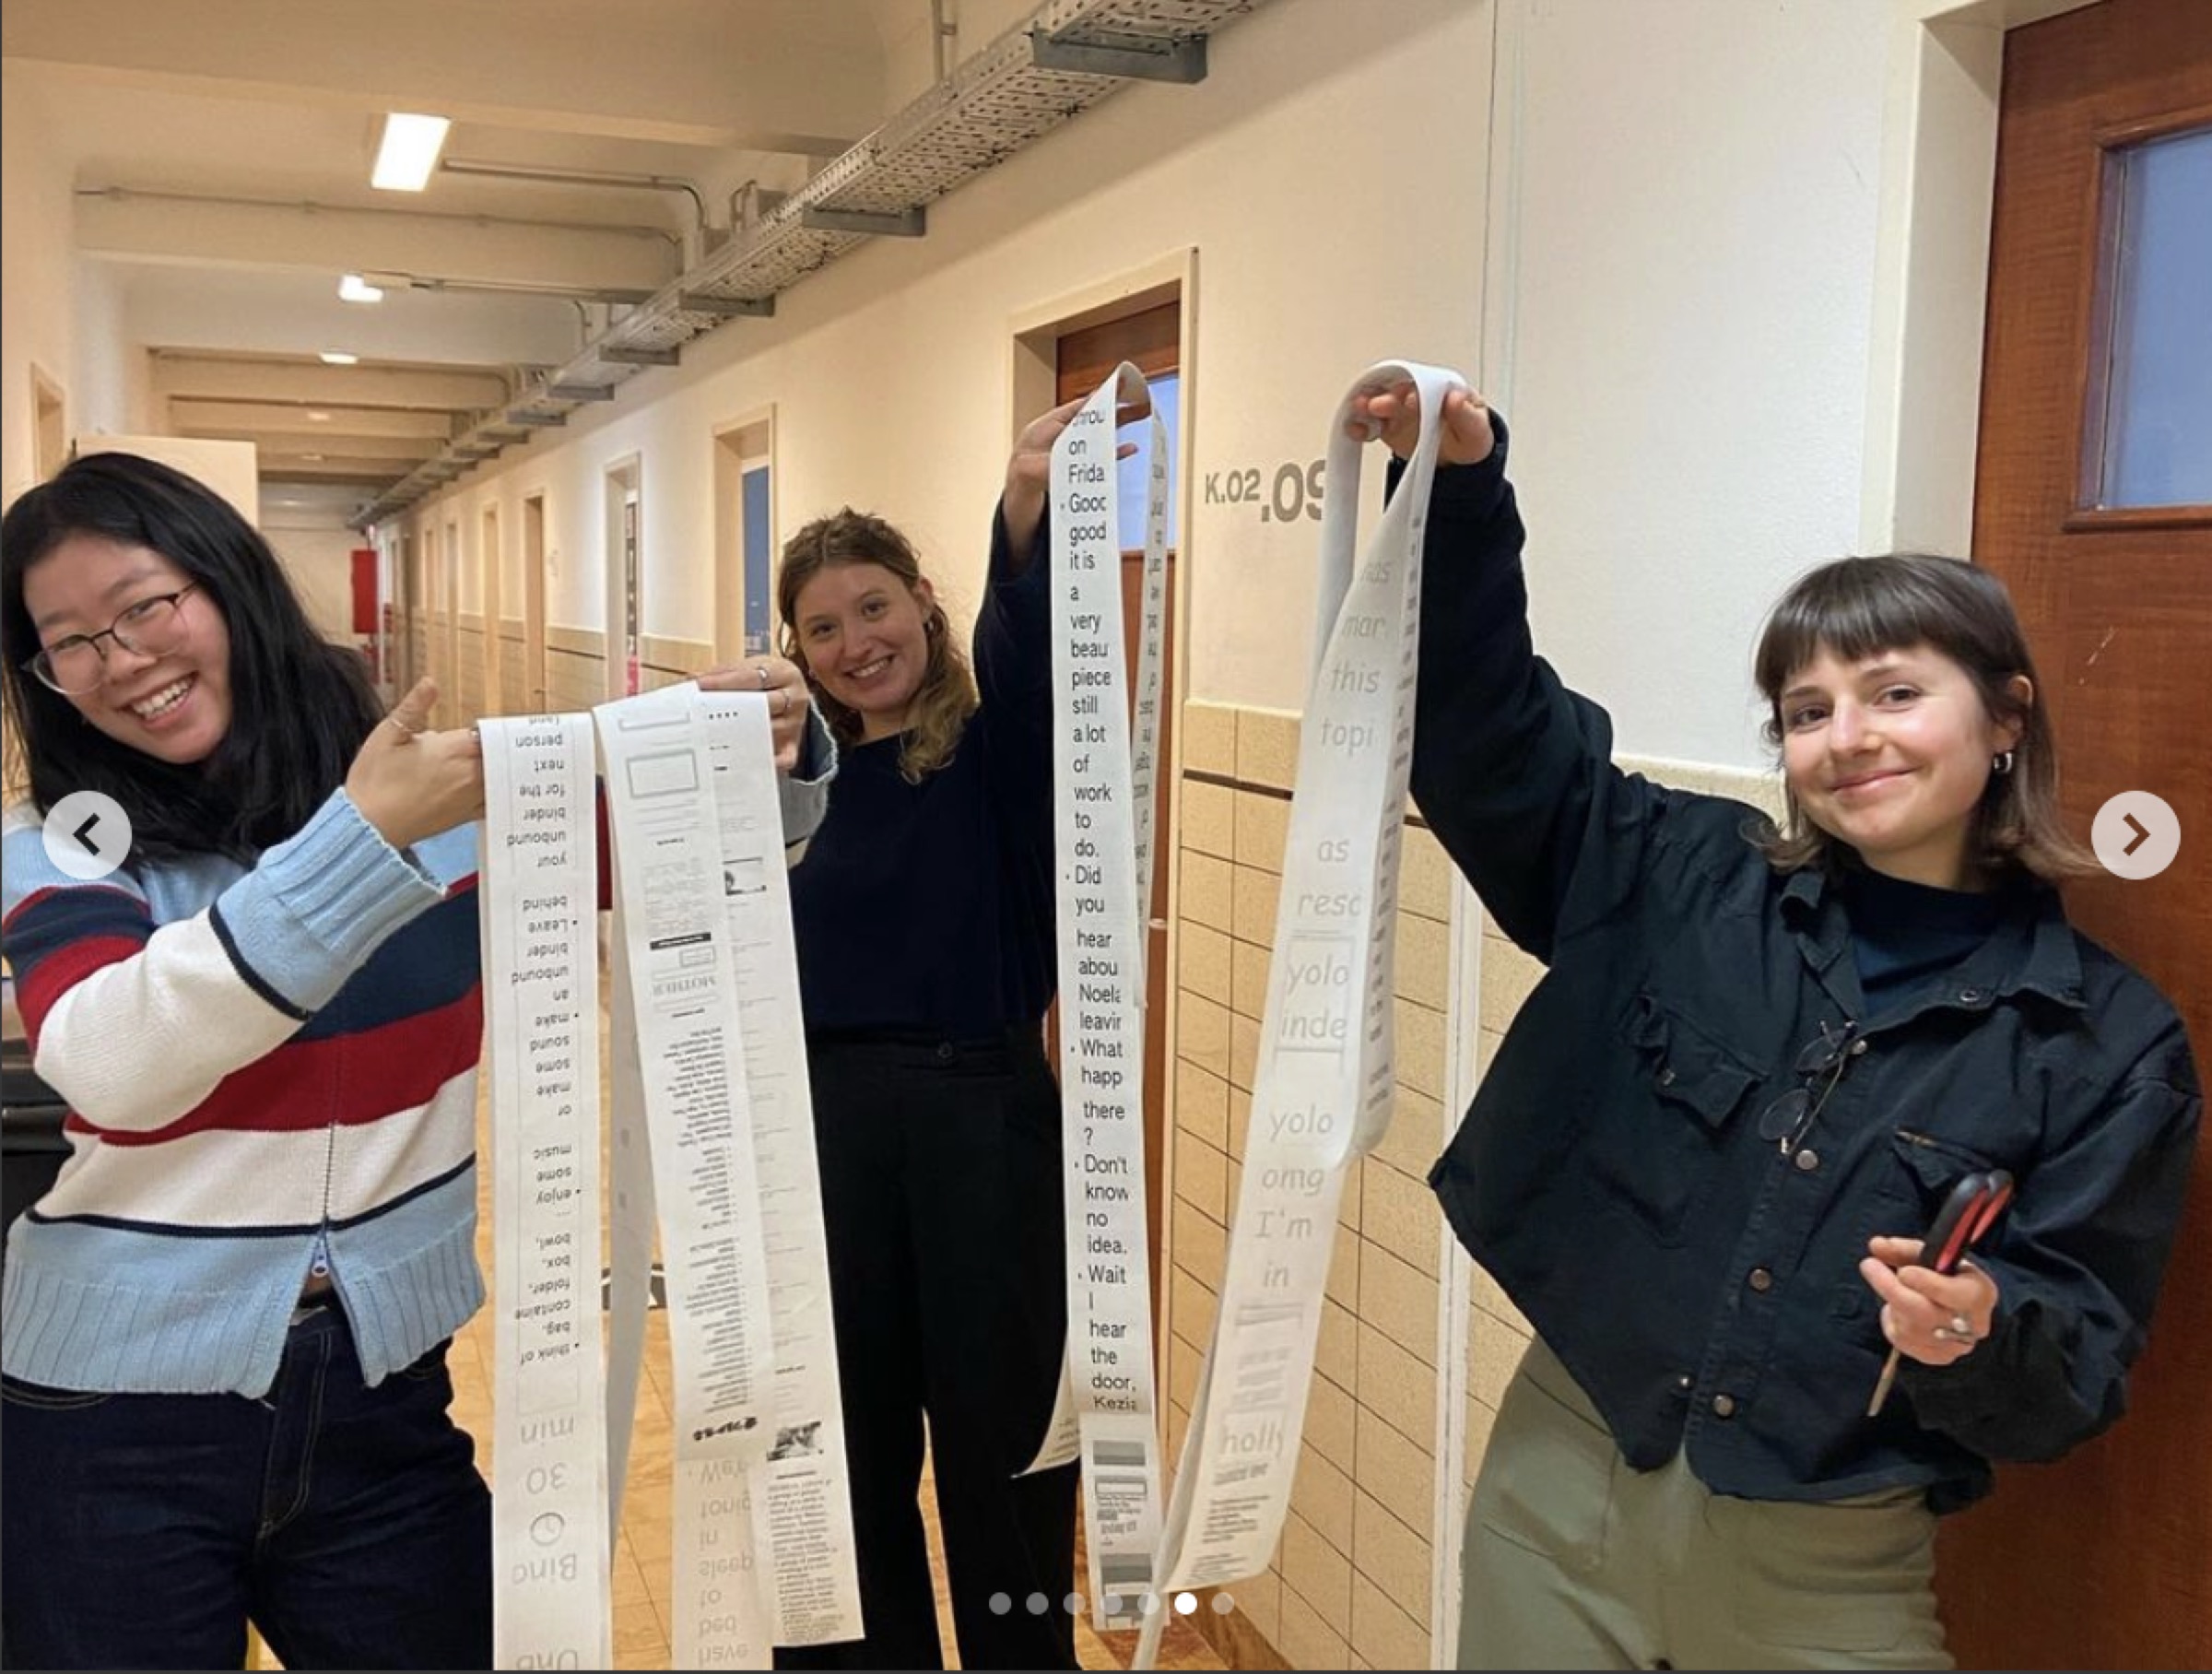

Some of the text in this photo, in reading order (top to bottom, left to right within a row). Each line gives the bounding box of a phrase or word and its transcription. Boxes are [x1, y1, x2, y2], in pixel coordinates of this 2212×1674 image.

[1069, 440, 1086, 454] on
[1069, 464, 1105, 483] Frida
[1070, 523, 1106, 548] good
[1071, 551, 1095, 570] it is
[1070, 586, 1079, 601] a
[1070, 614, 1101, 634] very
[1071, 640, 1109, 658] beau
[1072, 667, 1112, 690] piece
[1331, 659, 1381, 694] this
[1073, 696, 1098, 714] still
[516, 735, 562, 747] person
[1073, 725, 1106, 743] a lot
[1321, 718, 1374, 756] topi
[535, 760, 564, 772] next
[1073, 754, 1090, 772] of
[520, 784, 565, 797] for the
[1075, 783, 1112, 801] work
[523, 808, 566, 820] binder
[1075, 812, 1091, 829] to
[507, 831, 566, 847] unbound
[1075, 839, 1099, 857] do.
[1317, 837, 1349, 863] as
[537, 852, 568, 867] your
[1076, 865, 1101, 884] Did
[523, 895, 568, 911] behind
[1075, 898, 1104, 916] you
[528, 919, 568, 933] Leave
[1077, 929, 1112, 948] hear
[527, 943, 568, 957] binder
[512, 966, 569, 984] unbound
[1078, 956, 1118, 976] abou
[1288, 954, 1349, 995] yolo
[553, 989, 569, 1001] an
[535, 1013, 570, 1028] make
[1281, 1012, 1348, 1040] inde
[530, 1035, 570, 1051] sound
[1080, 1039, 1123, 1057] What
[536, 1059, 570, 1073] some
[1081, 1066, 1123, 1090] happ
[537, 1083, 571, 1095] make
[558, 1105, 571, 1115] or
[1083, 1101, 1124, 1119] there
[1269, 1103, 1334, 1143] yolo
[1084, 1127, 1093, 1146] ?
[534, 1145, 571, 1160] music
[1085, 1154, 1128, 1173] Don't
[536, 1167, 571, 1181] some
[1261, 1165, 1325, 1197] omg
[536, 1189, 571, 1205] enjoy
[1086, 1182, 1128, 1200] know
[1087, 1212, 1109, 1226] no
[1255, 1210, 1312, 1239] I'm
[1088, 1266, 1126, 1284] Wait
[1263, 1261, 1289, 1288] in
[515, 1299, 571, 1319] containe
[1089, 1319, 1127, 1338] hear
[520, 1344, 570, 1365] think of
[1091, 1347, 1118, 1364] the
[521, 1416, 574, 1448] min
[525, 1462, 567, 1494] 30
